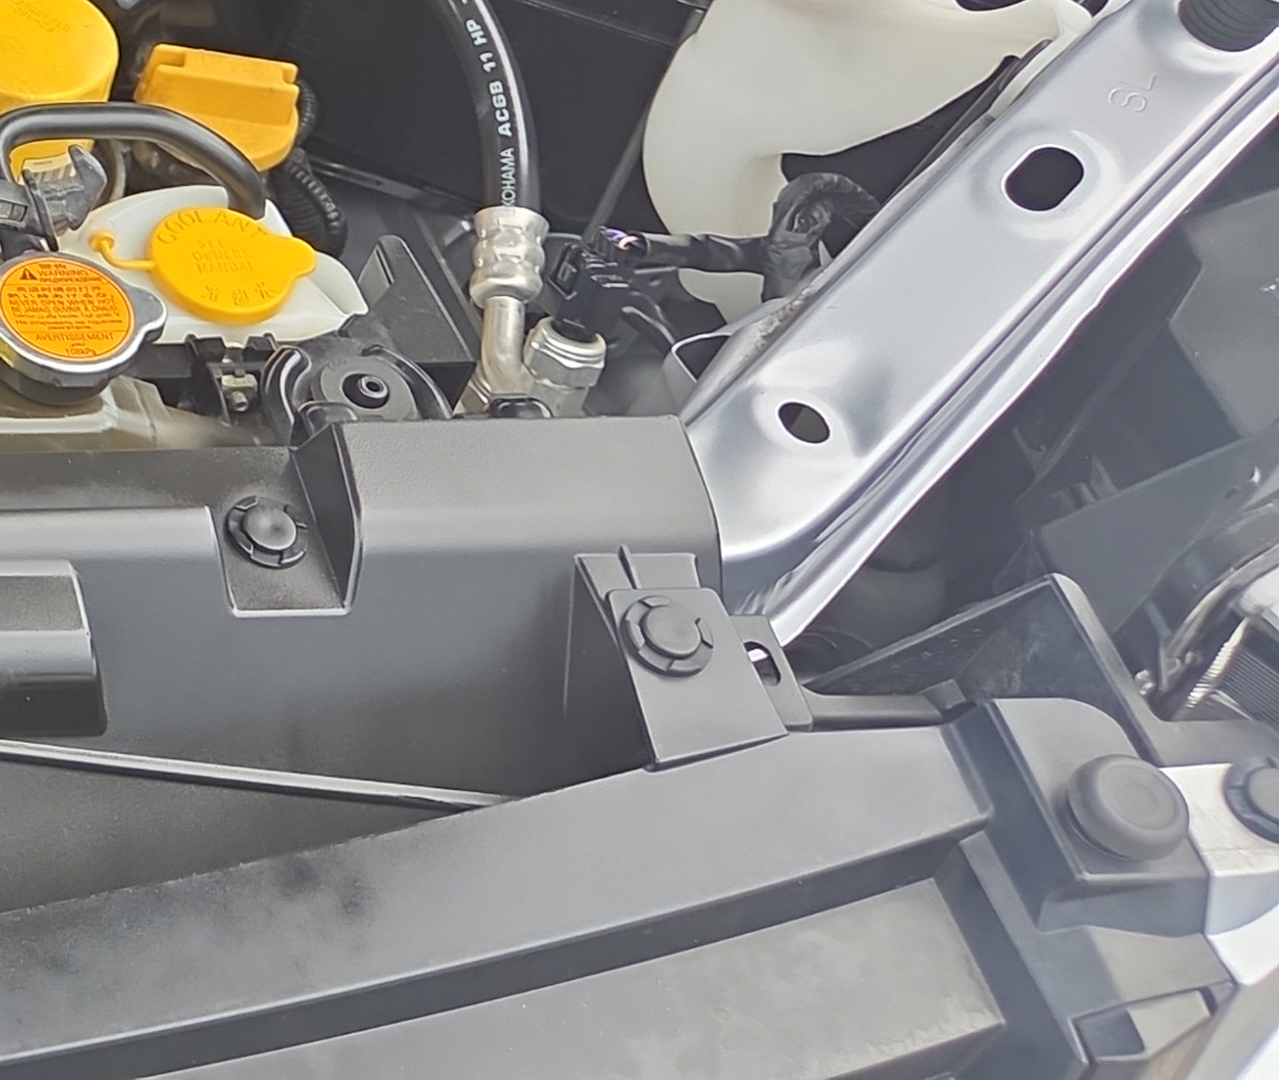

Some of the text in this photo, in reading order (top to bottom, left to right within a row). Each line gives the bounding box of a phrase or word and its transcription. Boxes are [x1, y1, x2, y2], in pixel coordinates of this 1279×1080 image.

[465, 18, 487, 46] HP
[478, 51, 496, 72] 11
[156, 210, 268, 244] COOLANT
[195, 260, 254, 273] MANUAL
[35, 332, 114, 341] AVERTISSEMENT
